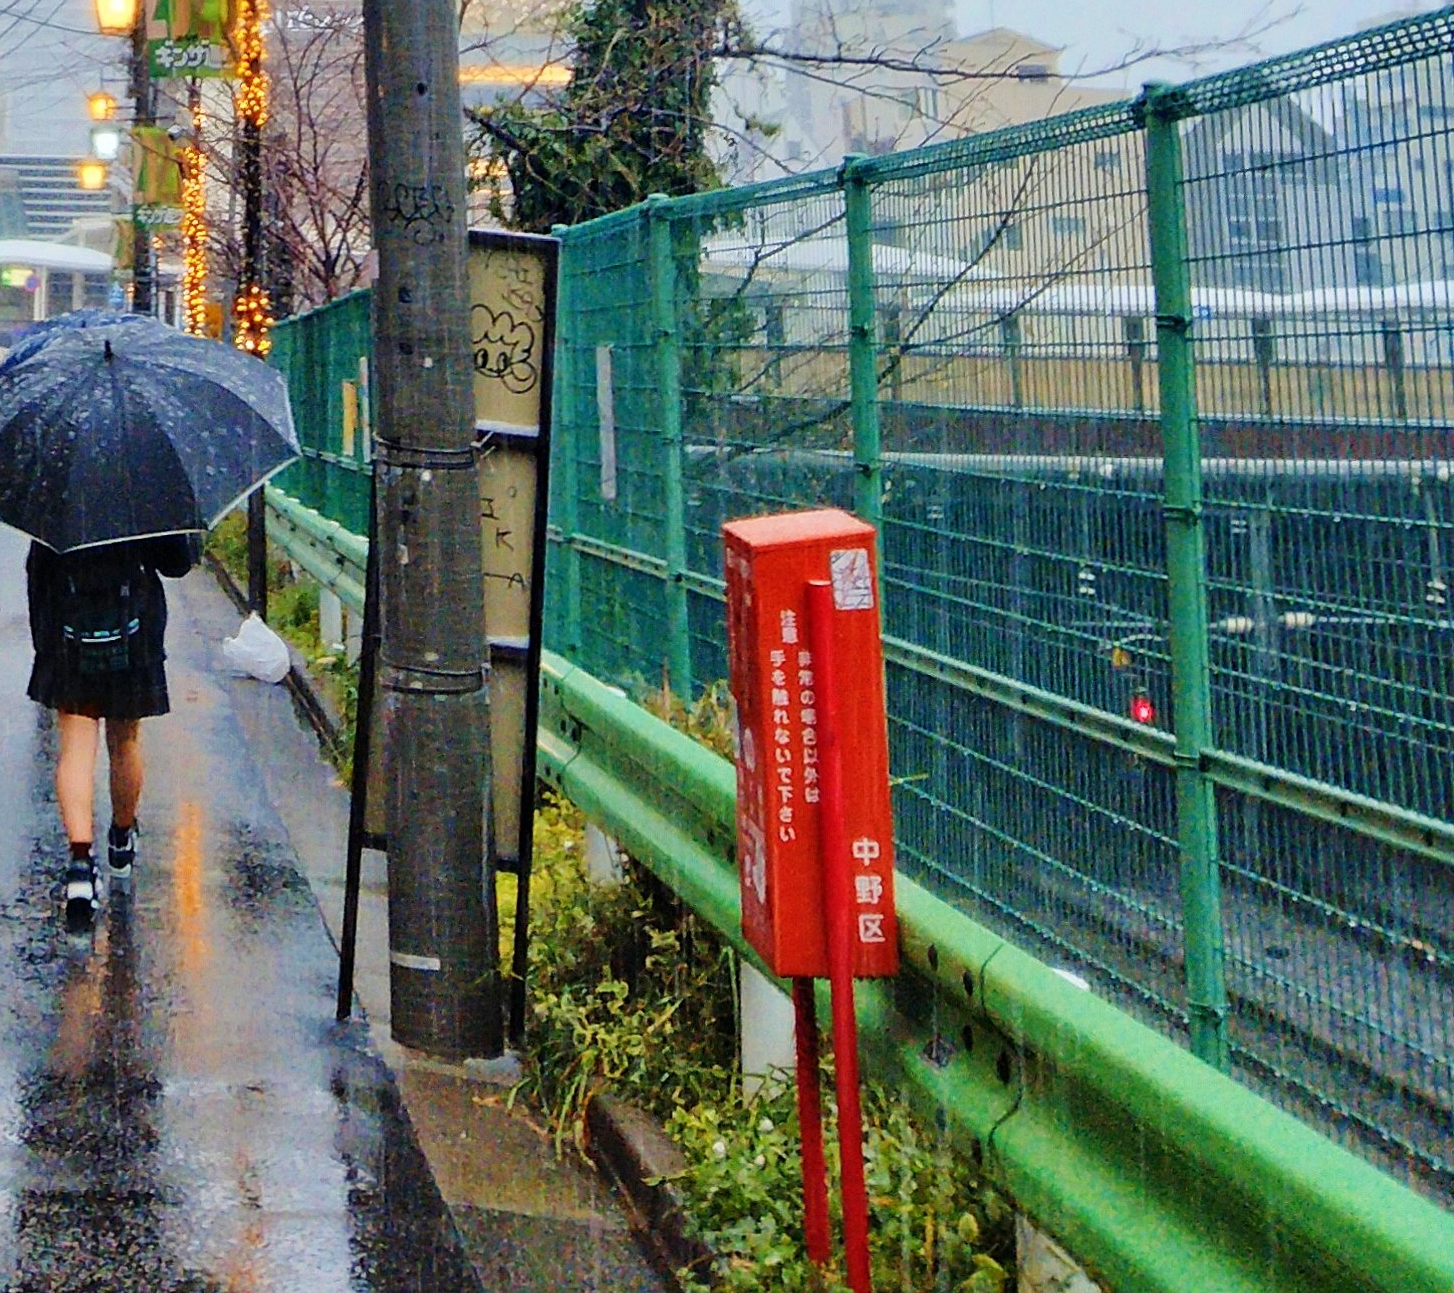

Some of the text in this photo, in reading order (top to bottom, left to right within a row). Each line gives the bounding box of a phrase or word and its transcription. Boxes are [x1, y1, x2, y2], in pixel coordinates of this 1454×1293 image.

[779, 609, 799, 645] 注意
[770, 649, 796, 843] 手を触れないで下さい
[798, 649, 821, 804] 非常の場合以外は
[852, 836, 886, 944] 中野区
